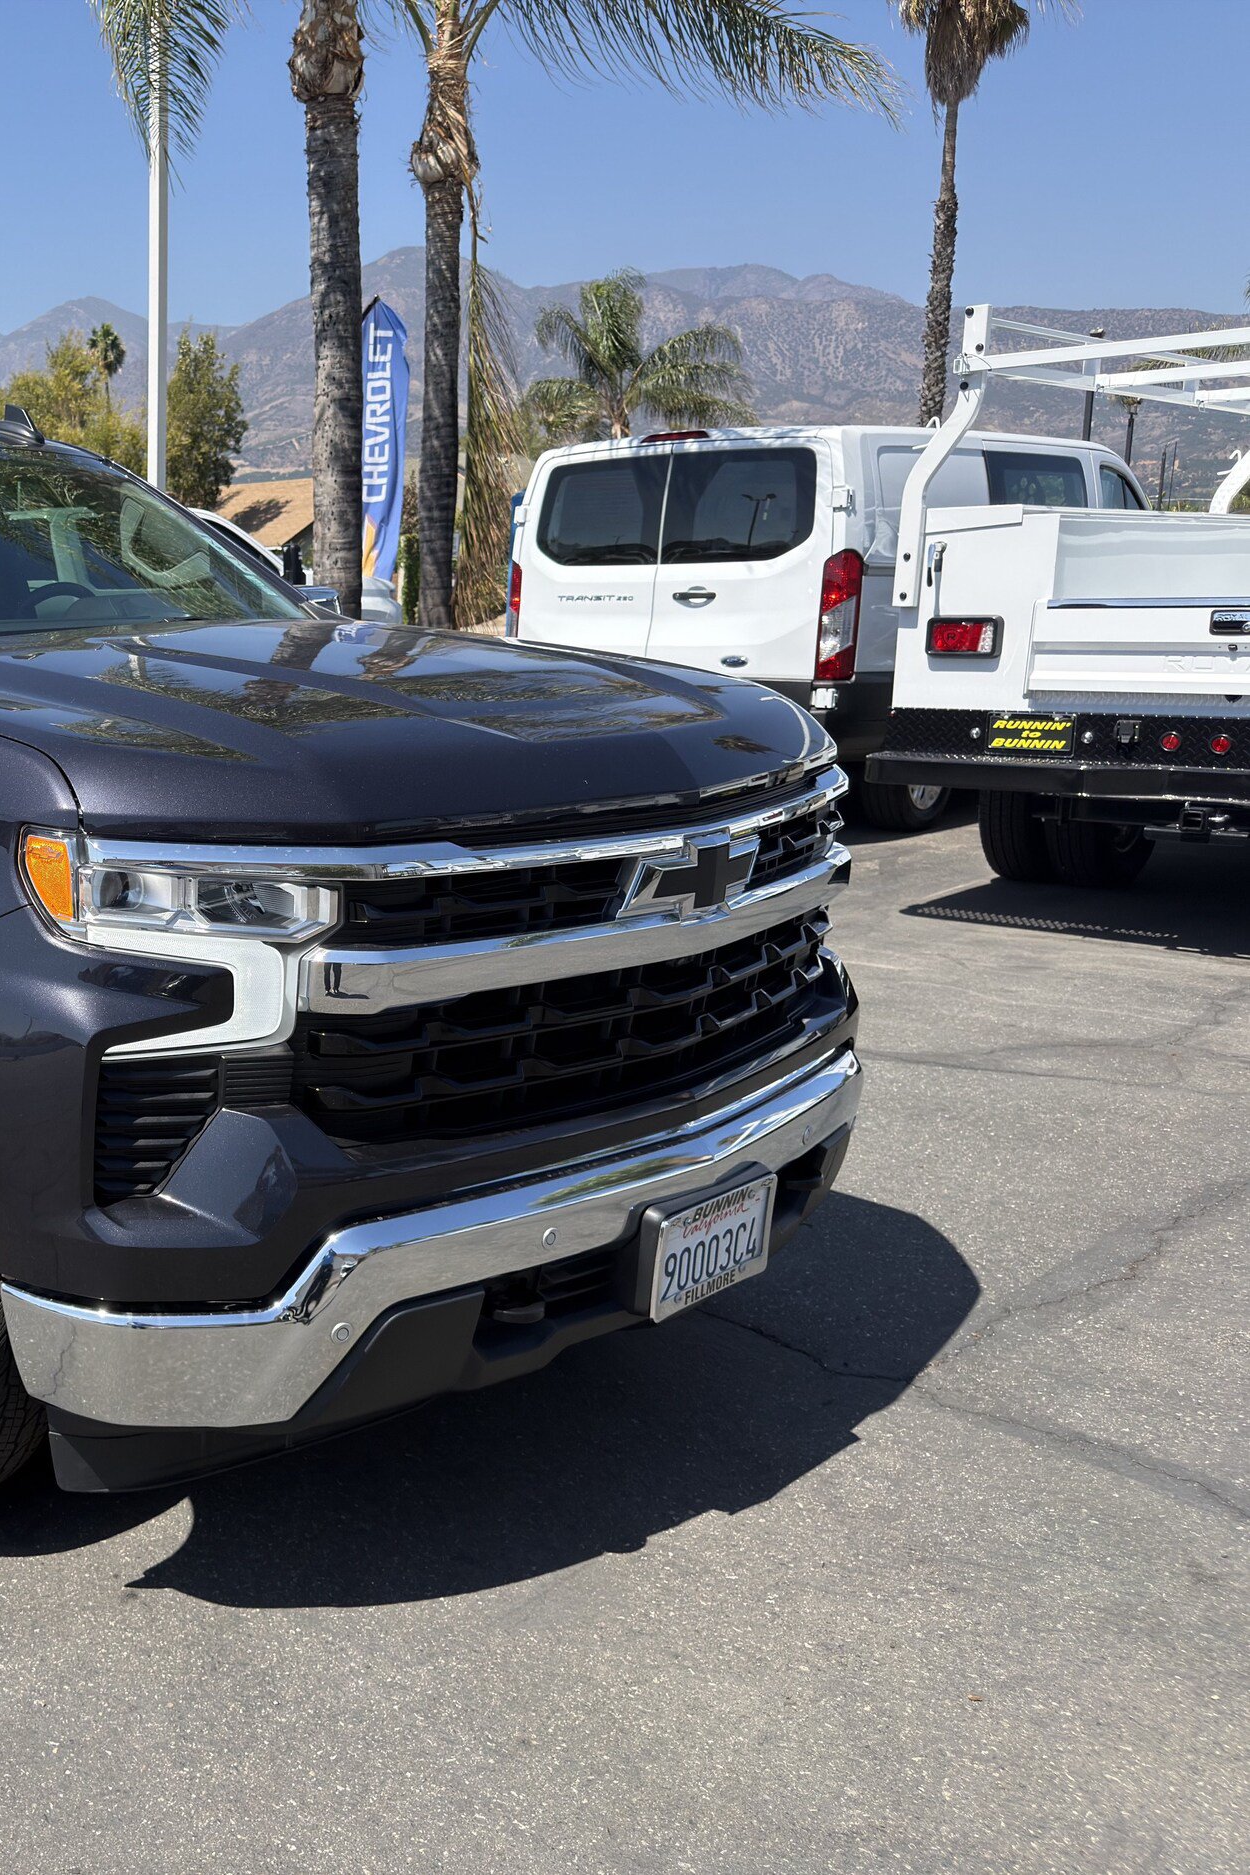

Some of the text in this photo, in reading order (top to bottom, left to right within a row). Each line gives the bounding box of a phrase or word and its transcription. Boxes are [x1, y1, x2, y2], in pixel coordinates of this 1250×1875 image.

[362, 322, 394, 503] CHEVROLET
[557, 594, 616, 602] TRANSIT
[993, 719, 1072, 731] RUNNIN'
[1021, 730, 1042, 738] to
[990, 738, 1067, 750] BUNNIN
[682, 1202, 750, 1240] California
[692, 1187, 750, 1222] BUNNIN
[660, 1216, 757, 1304] 90003C4
[684, 1269, 736, 1306] FILLMORE
